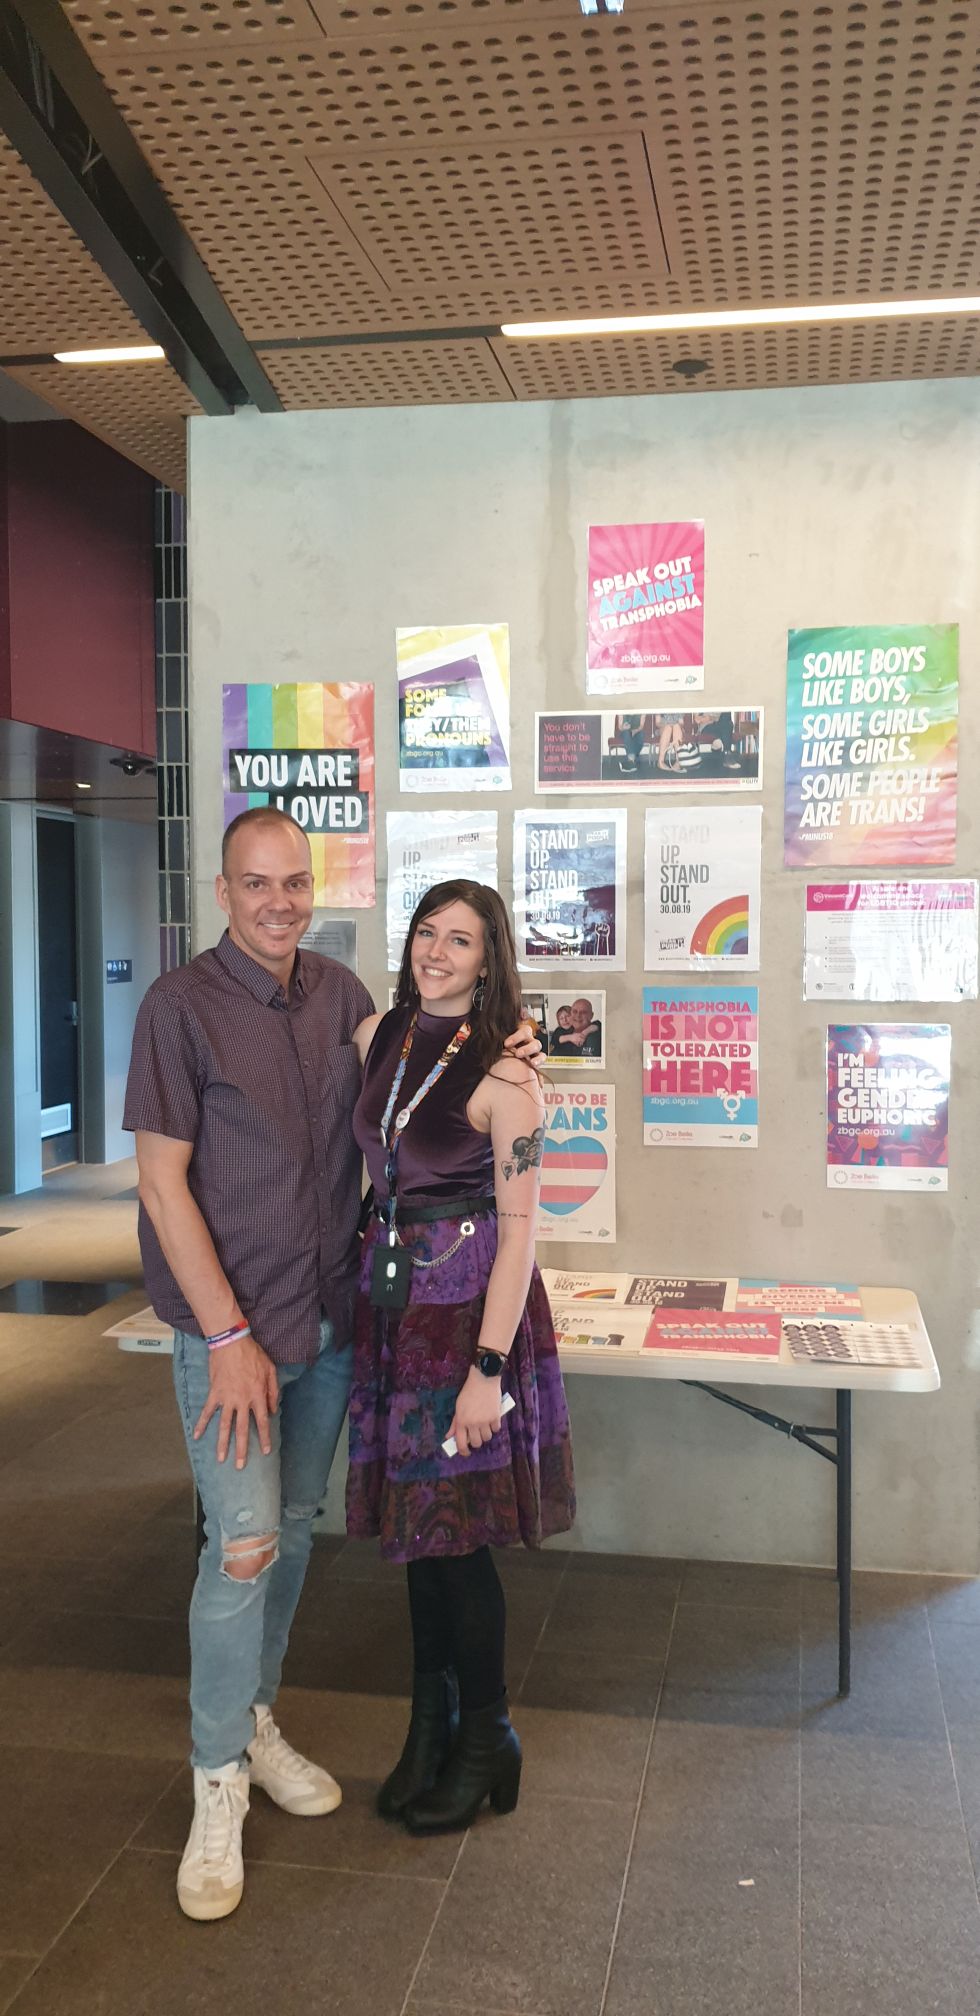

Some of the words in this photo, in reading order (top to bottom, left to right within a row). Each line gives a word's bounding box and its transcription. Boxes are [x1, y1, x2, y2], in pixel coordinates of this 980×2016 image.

[592, 567, 651, 598] SPEAK
[653, 556, 692, 581] OUT
[599, 573, 695, 618] AGAINST
[600, 594, 702, 632] TRANSPHOBIA
[802, 650, 865, 680] SOME
[870, 646, 926, 675] BOYS
[801, 679, 845, 708] LIKE
[850, 675, 911, 705] BOYS,
[544, 723, 561, 732] You
[563, 722, 586, 732] don't
[801, 711, 862, 741] SOME
[868, 708, 930, 736] GIRLS
[544, 733, 565, 742] have
[567, 733, 576, 742] to
[579, 733, 591, 742] be
[579, 744, 589, 752] to
[801, 740, 844, 768] LIKE
[849, 736, 916, 765] GIRLS.
[234, 755, 289, 787] YOU
[297, 755, 352, 787] ARE
[800, 772, 862, 801] SOME
[867, 767, 943, 796] PEOPLE
[800, 801, 843, 828] ARE
[849, 797, 926, 826] TRANS!
[530, 829, 579, 850] STAND
[661, 825, 710, 844] STAND
[530, 850, 550, 869] UP.
[661, 845, 680, 865] UP.
[530, 870, 578, 890] STAND
[660, 865, 710, 884] STAND
[660, 885, 691, 904] OUT.
[659, 905, 691, 914] 30.08.19
[651, 1001, 752, 1013] TRANSPHOBIA
[650, 1014, 677, 1041] IS
[684, 1014, 752, 1041] NOT
[651, 1043, 752, 1058] TOLERATED
[837, 1053, 864, 1068] I'M
[650, 1060, 752, 1094] HERE
[837, 1068, 940, 1089] FEELING
[567, 1093, 587, 1106] TO
[590, 1094, 608, 1106] BE
[546, 1107, 608, 1132] ANS
[837, 1127, 895, 1137] zbgc.org.au
[637, 1279, 688, 1288] STAND
